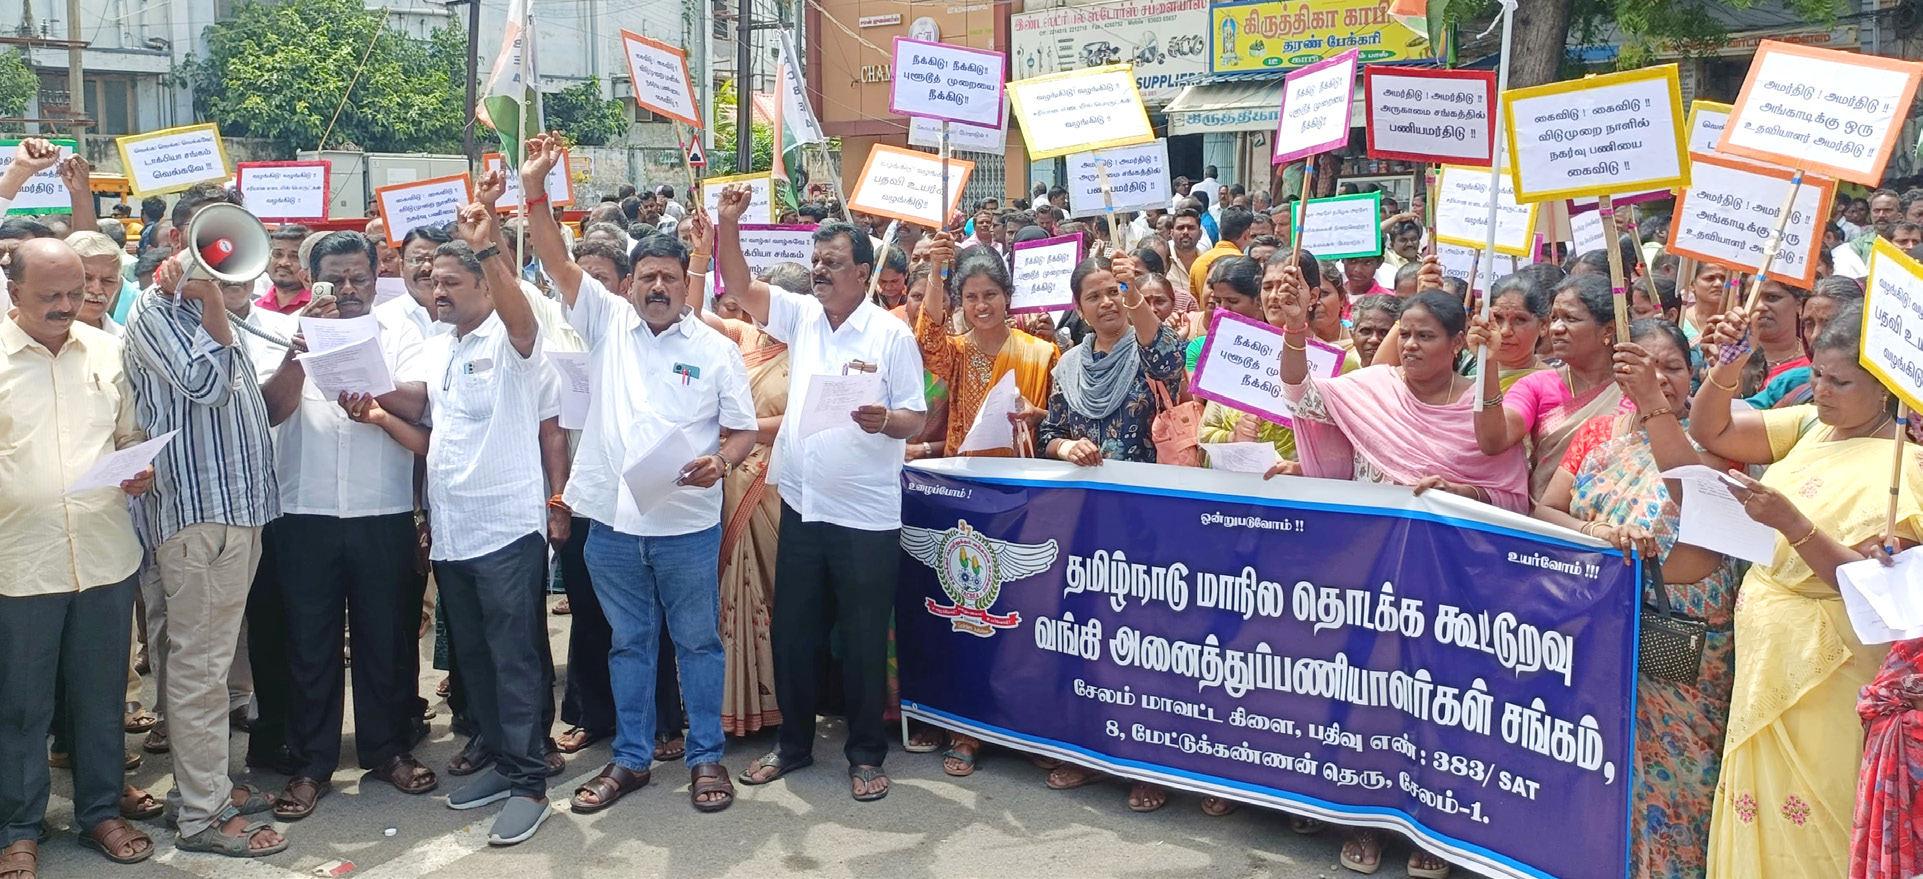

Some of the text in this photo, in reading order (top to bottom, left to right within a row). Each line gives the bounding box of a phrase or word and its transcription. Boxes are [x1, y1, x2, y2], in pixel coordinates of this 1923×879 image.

[1243, 4, 1338, 40] கிருத்திகா
[947, 77, 995, 92] முறையை
[1382, 88, 1423, 102] அமர்திடு
[1431, 92, 1474, 105] அமர்திடு
[1380, 104, 1486, 120] அருகாமை சங்கத்தில்
[1534, 107, 1579, 124] கைவிடு
[1592, 98, 1641, 115] கைவிடு
[1389, 121, 1466, 141] பணியமர்திடு
[1538, 118, 1650, 143] விடுமுறை நாளில்
[1844, 120, 1874, 138] ஒரு
[1550, 140, 1643, 162] நகர்வு பணியை
[1567, 160, 1619, 178] கைவிடு
[1696, 190, 1743, 210] அமர்திடு
[773, 248, 805, 259] சங்கம்
[1875, 304, 1903, 337] பதவி
[908, 482, 966, 498] உழைப்போம்
[1201, 511, 1292, 531] ஒன்றுபடுவோம்
[1508, 551, 1582, 575] உயர்வோம்
[1064, 549, 1574, 687] தமிழ்நாடு மாநில தொடக்க கூட்டுறவு
[1034, 611, 1616, 786] வங்கி அனைத்துப்பணியாளர்கள் சங்கம்,
[1073, 678, 1136, 706] சேலம்
[1141, 694, 1224, 723] மாவட்ட
[1228, 707, 1303, 739] கிளை,
[1308, 722, 1363, 752] பதிவு
[1498, 770, 1540, 800] SAT
[1105, 720, 1490, 824] 8, மேட்டுக்கண்ணன் தெரு, சேலம்-1.
